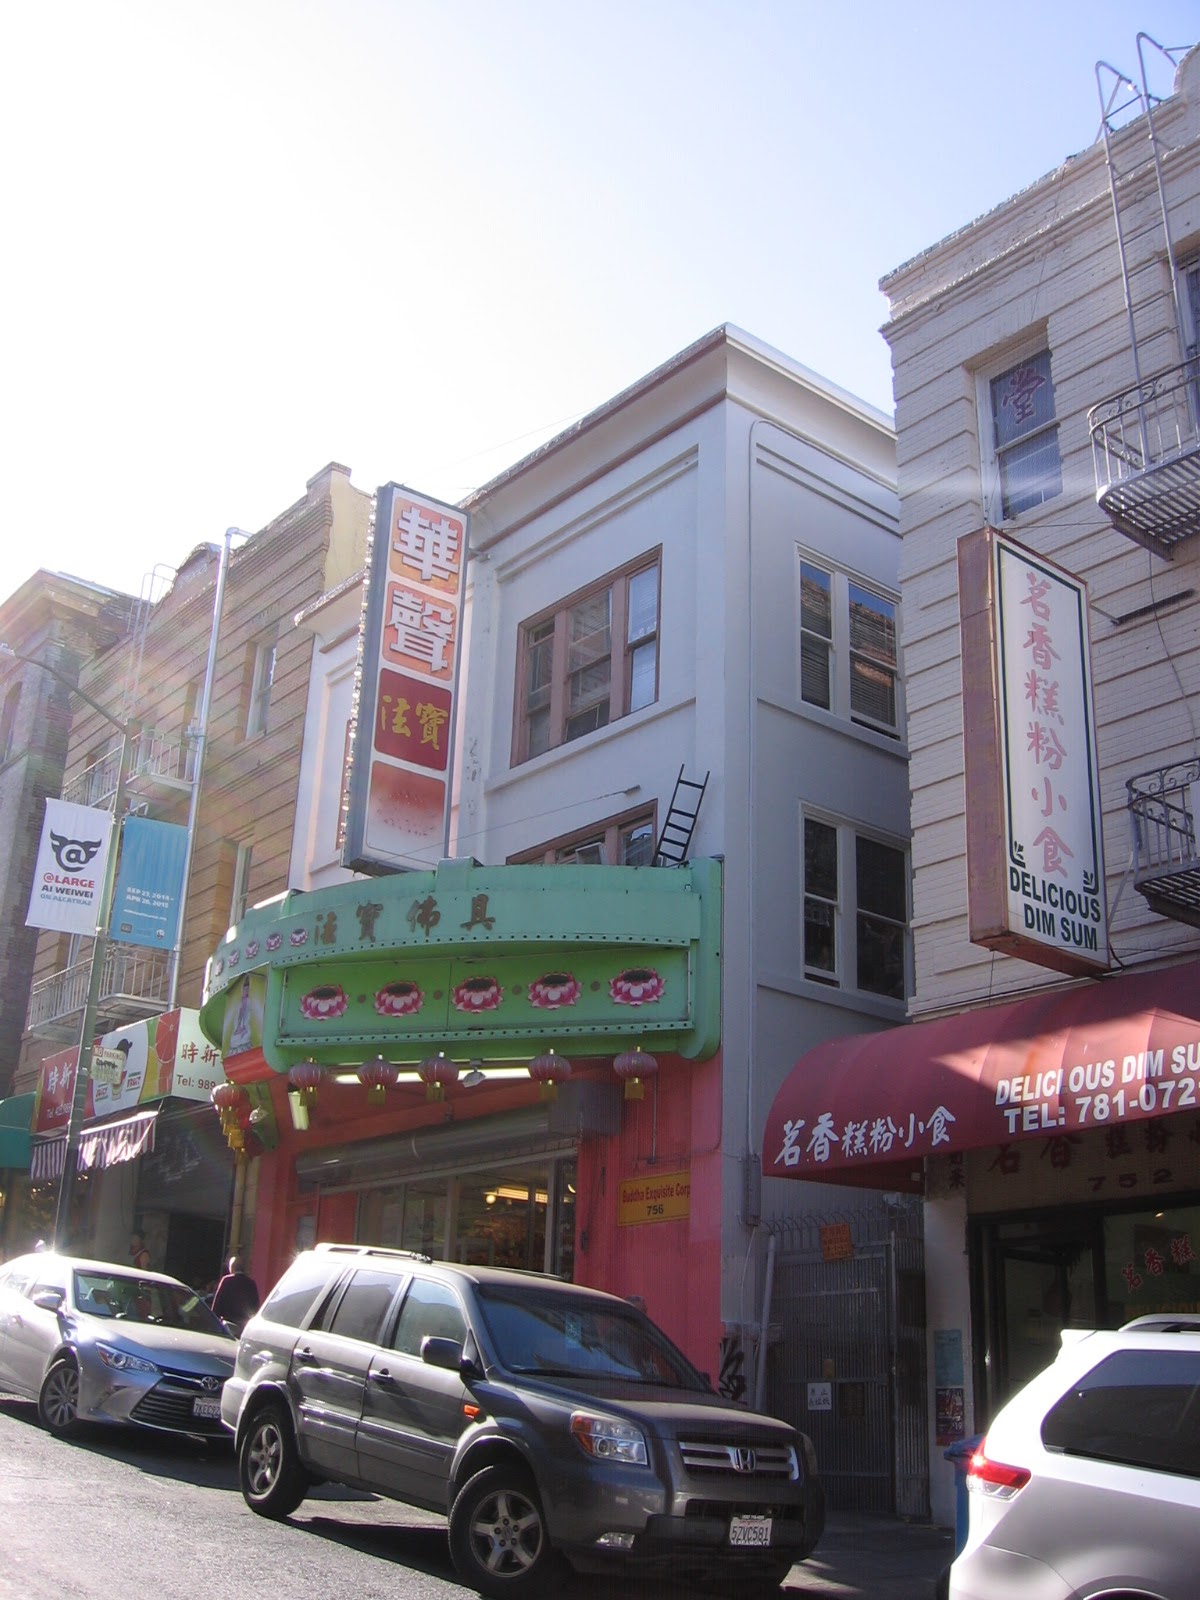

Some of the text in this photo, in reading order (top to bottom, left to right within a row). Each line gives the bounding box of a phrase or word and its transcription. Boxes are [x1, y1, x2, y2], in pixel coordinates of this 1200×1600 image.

[1020, 571, 1074, 878] 茗香糕粉小食
[41, 884, 94, 899] AI WEIWEI
[43, 872, 95, 888] @LARGE
[1009, 866, 1101, 923] DELICIOUS
[1024, 903, 1098, 952] DIM SUM
[176, 1074, 195, 1087] Tel:
[1121, 1049, 1164, 1084] DIM
[1003, 1077, 1200, 1134] TEL: 781-072
[773, 1105, 956, 1166] 茗香糕粉小食
[646, 1204, 664, 1216] 756
[731, 1525, 770, 1541] 5ZVC581
